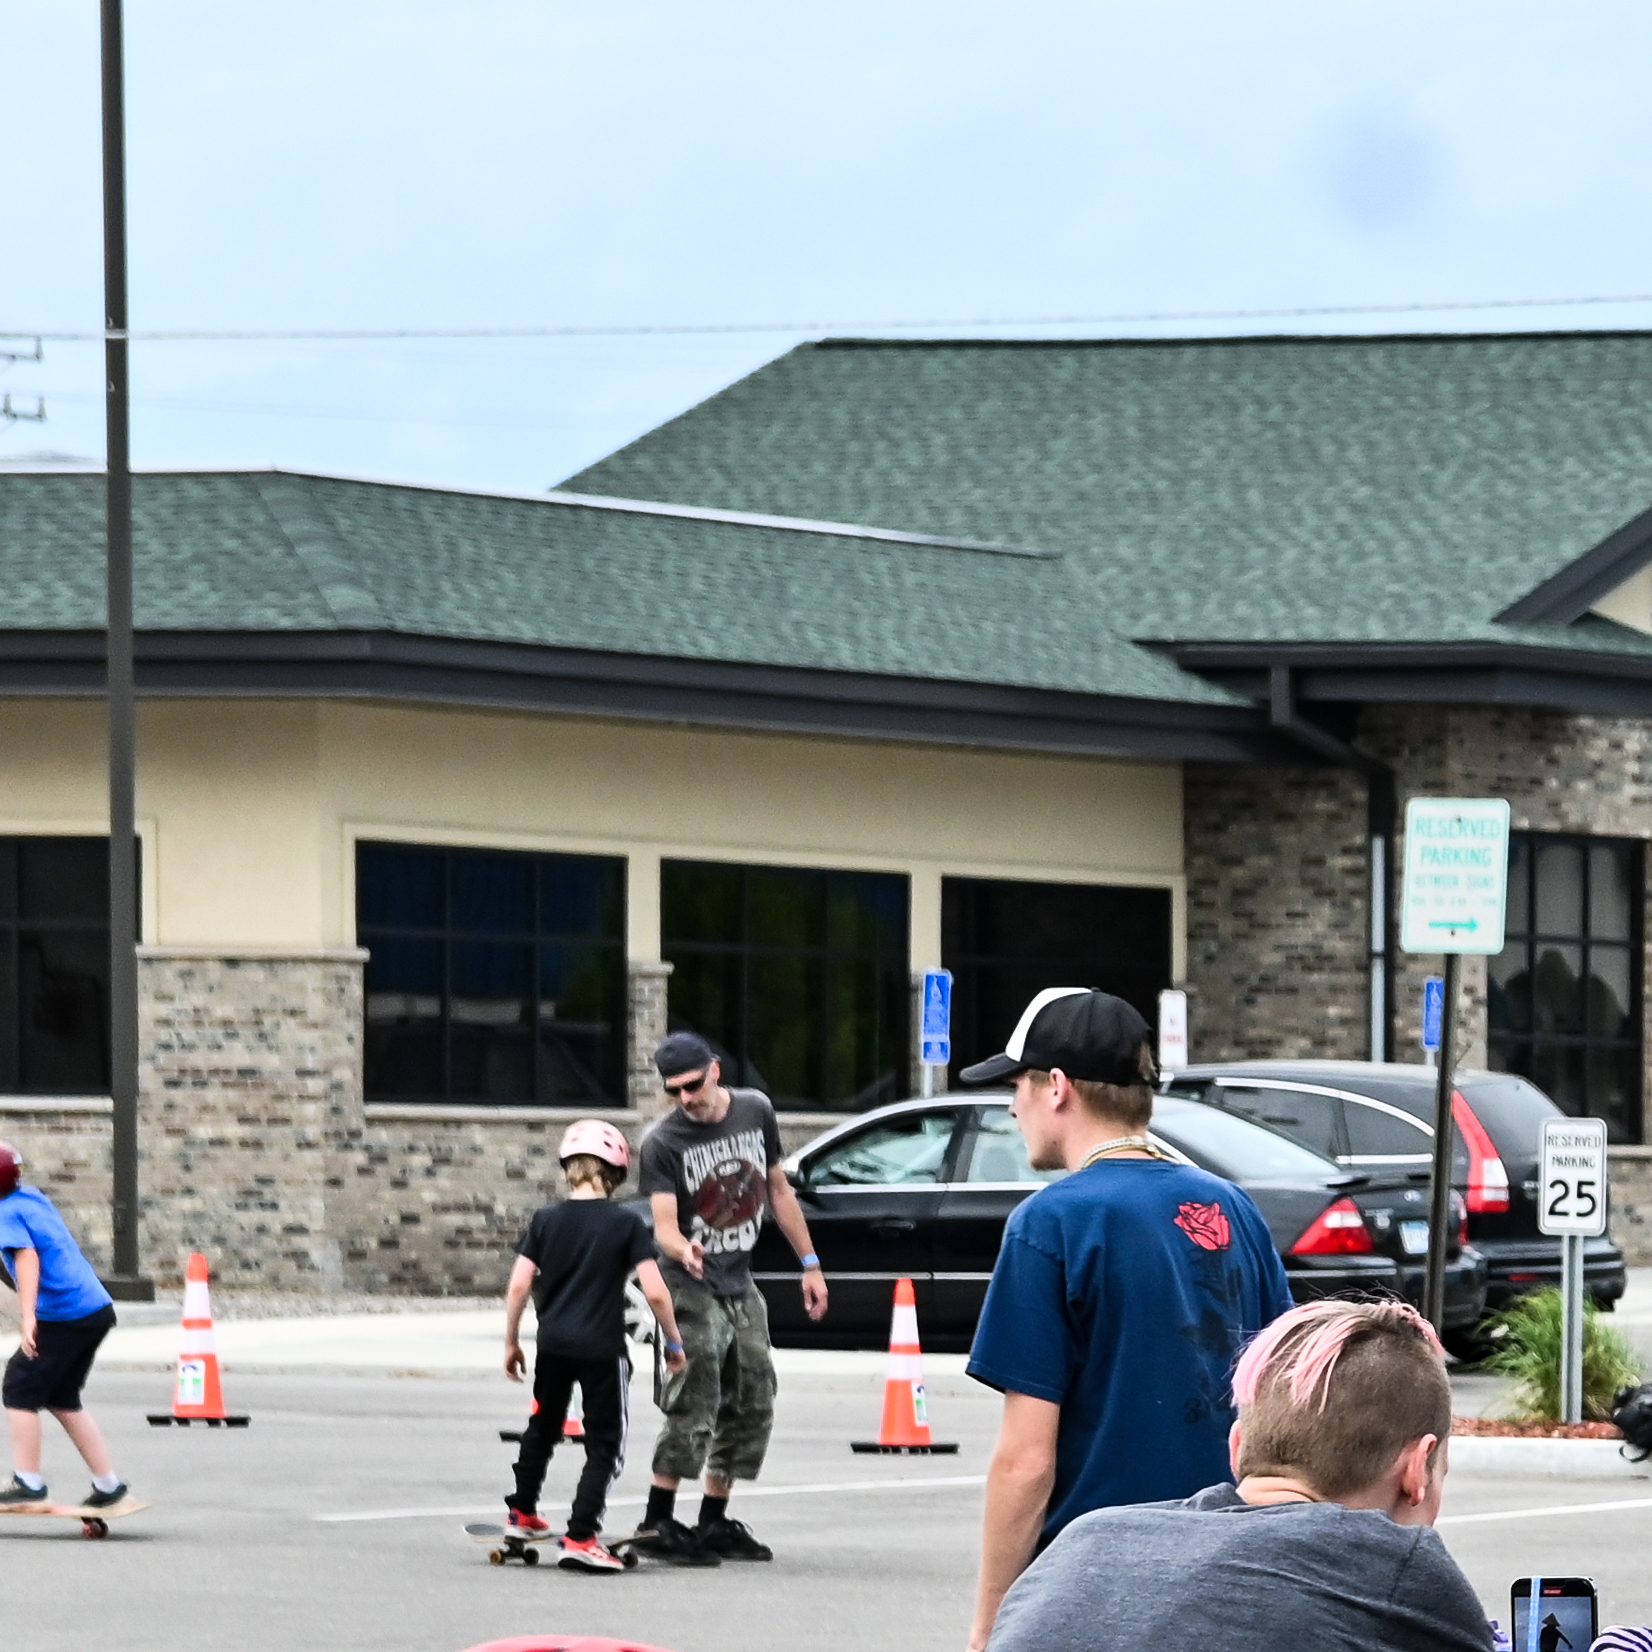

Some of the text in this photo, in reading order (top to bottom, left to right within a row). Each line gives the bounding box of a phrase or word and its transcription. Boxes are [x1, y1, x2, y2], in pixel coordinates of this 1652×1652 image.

[1416, 817, 1500, 838] RESERVED
[1420, 846, 1492, 867] PARKING
[1546, 1134, 1601, 1149] RESERVED
[1552, 1155, 1596, 1169] PARKING
[1548, 1179, 1597, 1218] 25
